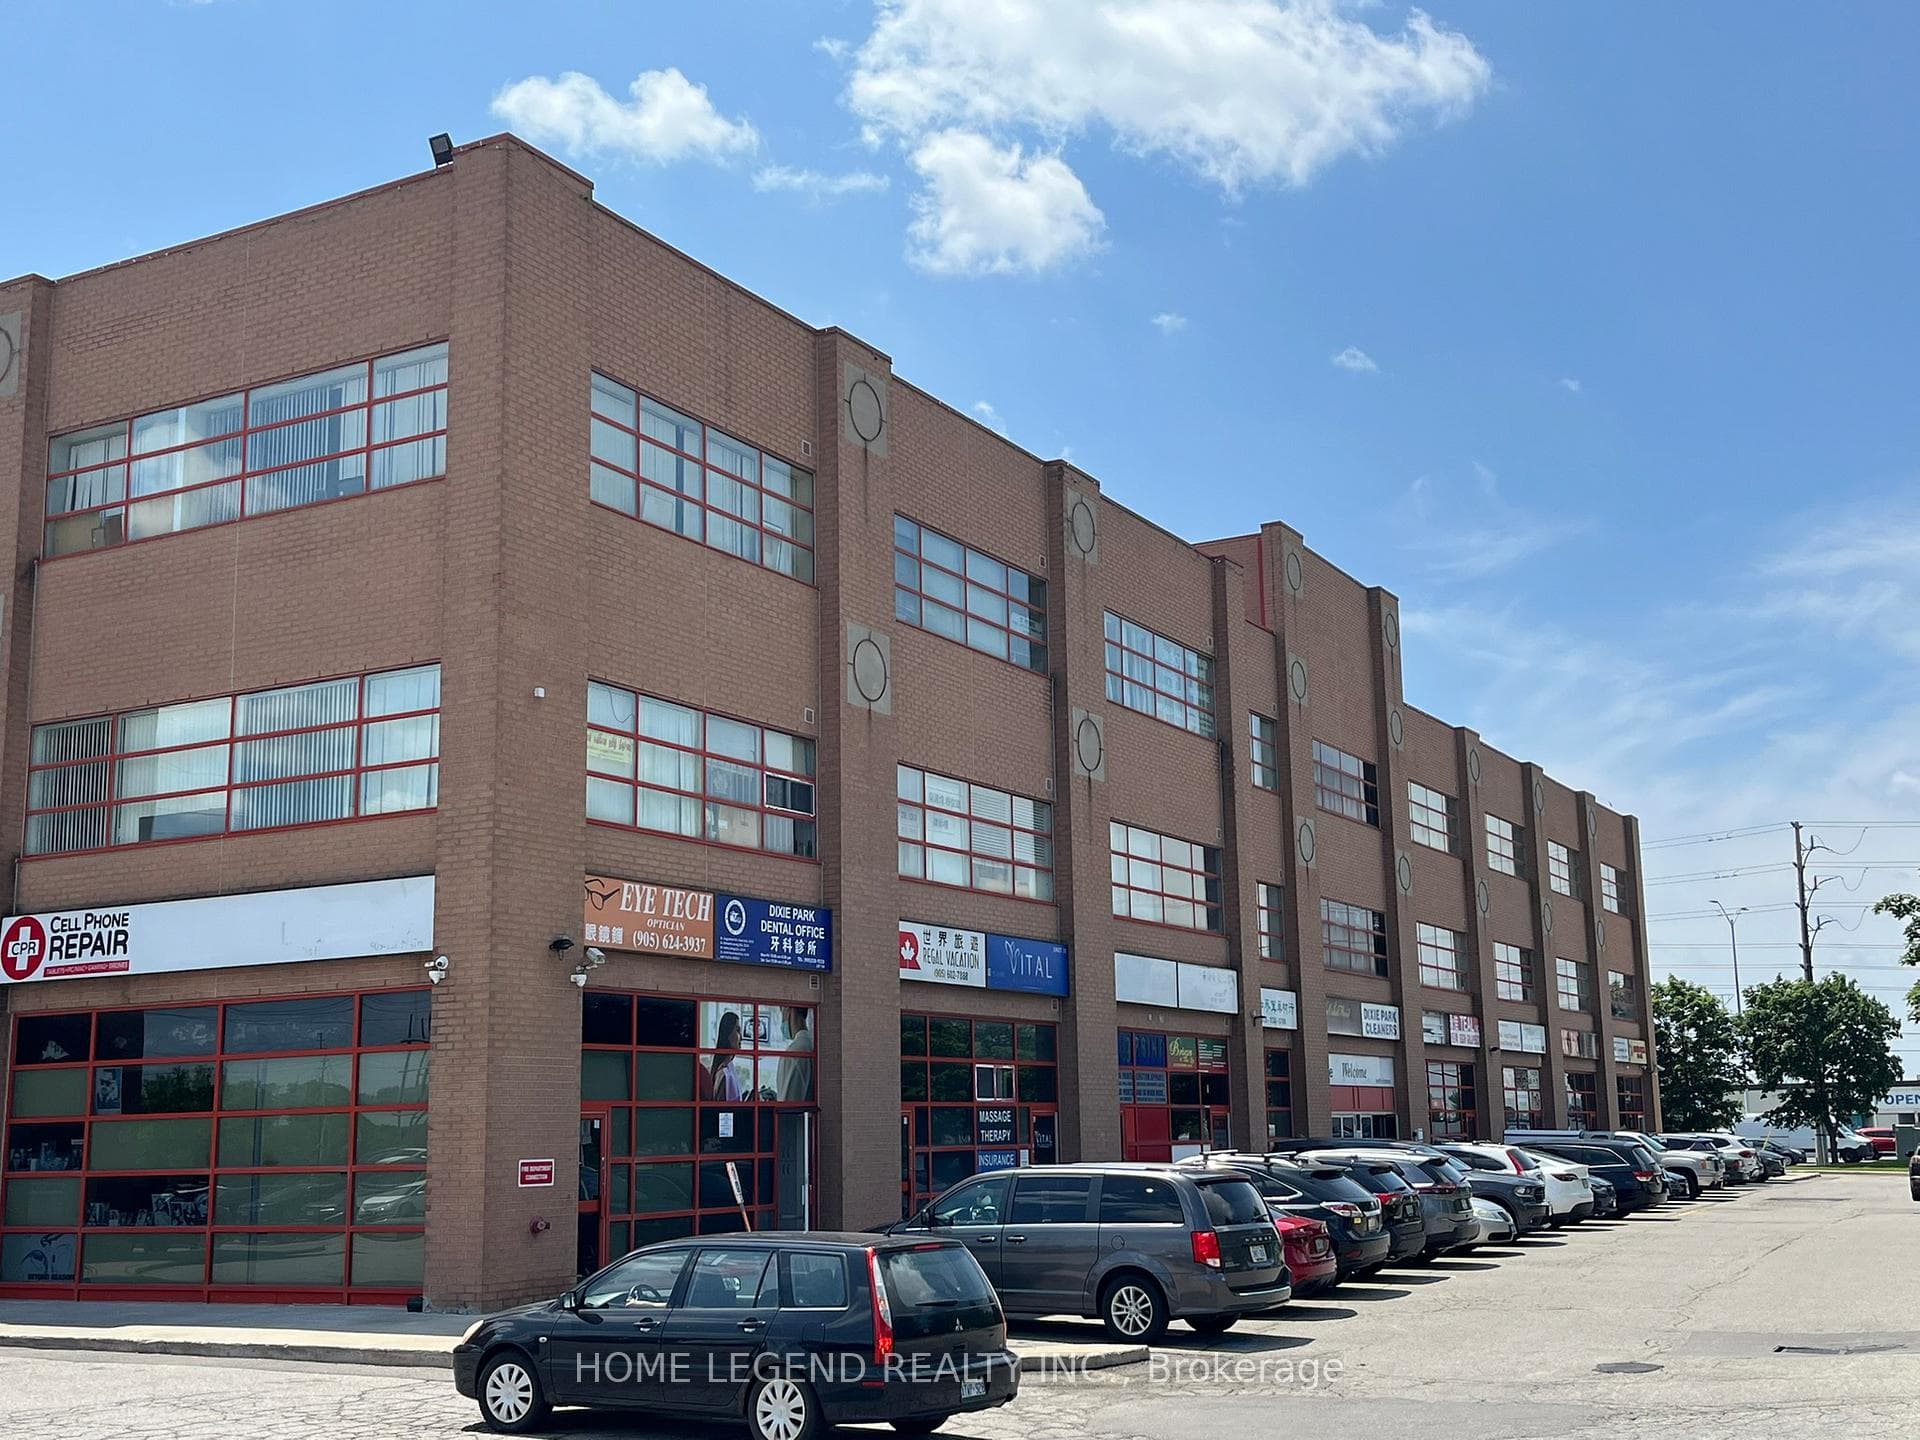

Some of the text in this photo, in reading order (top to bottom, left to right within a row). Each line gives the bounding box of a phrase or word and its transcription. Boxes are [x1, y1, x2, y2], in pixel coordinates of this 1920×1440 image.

[620, 883, 712, 921] EYE TECH
[769, 904, 815, 922] DIXIE PARK
[50, 912, 130, 933] CELL PHONE
[647, 918, 685, 931] OPTICIAN
[761, 920, 825, 939] DENTAL OFFICE
[11, 941, 36, 956] CPR
[49, 929, 129, 961] REPAIR
[633, 930, 706, 953] (905) 624-3937
[770, 936, 817, 956] 牙科診所
[923, 947, 980, 969] REGAL VACATION
[1363, 1007, 1380, 1021] DIXIE
[1381, 1009, 1397, 1024] PARK
[1365, 1022, 1397, 1036] CLEANERS
[1341, 1062, 1367, 1079] Welcome
[980, 1110, 1011, 1122] MASSAGE
[980, 1129, 1011, 1142] THERAPY
[978, 1154, 1015, 1166] INSURANCE
